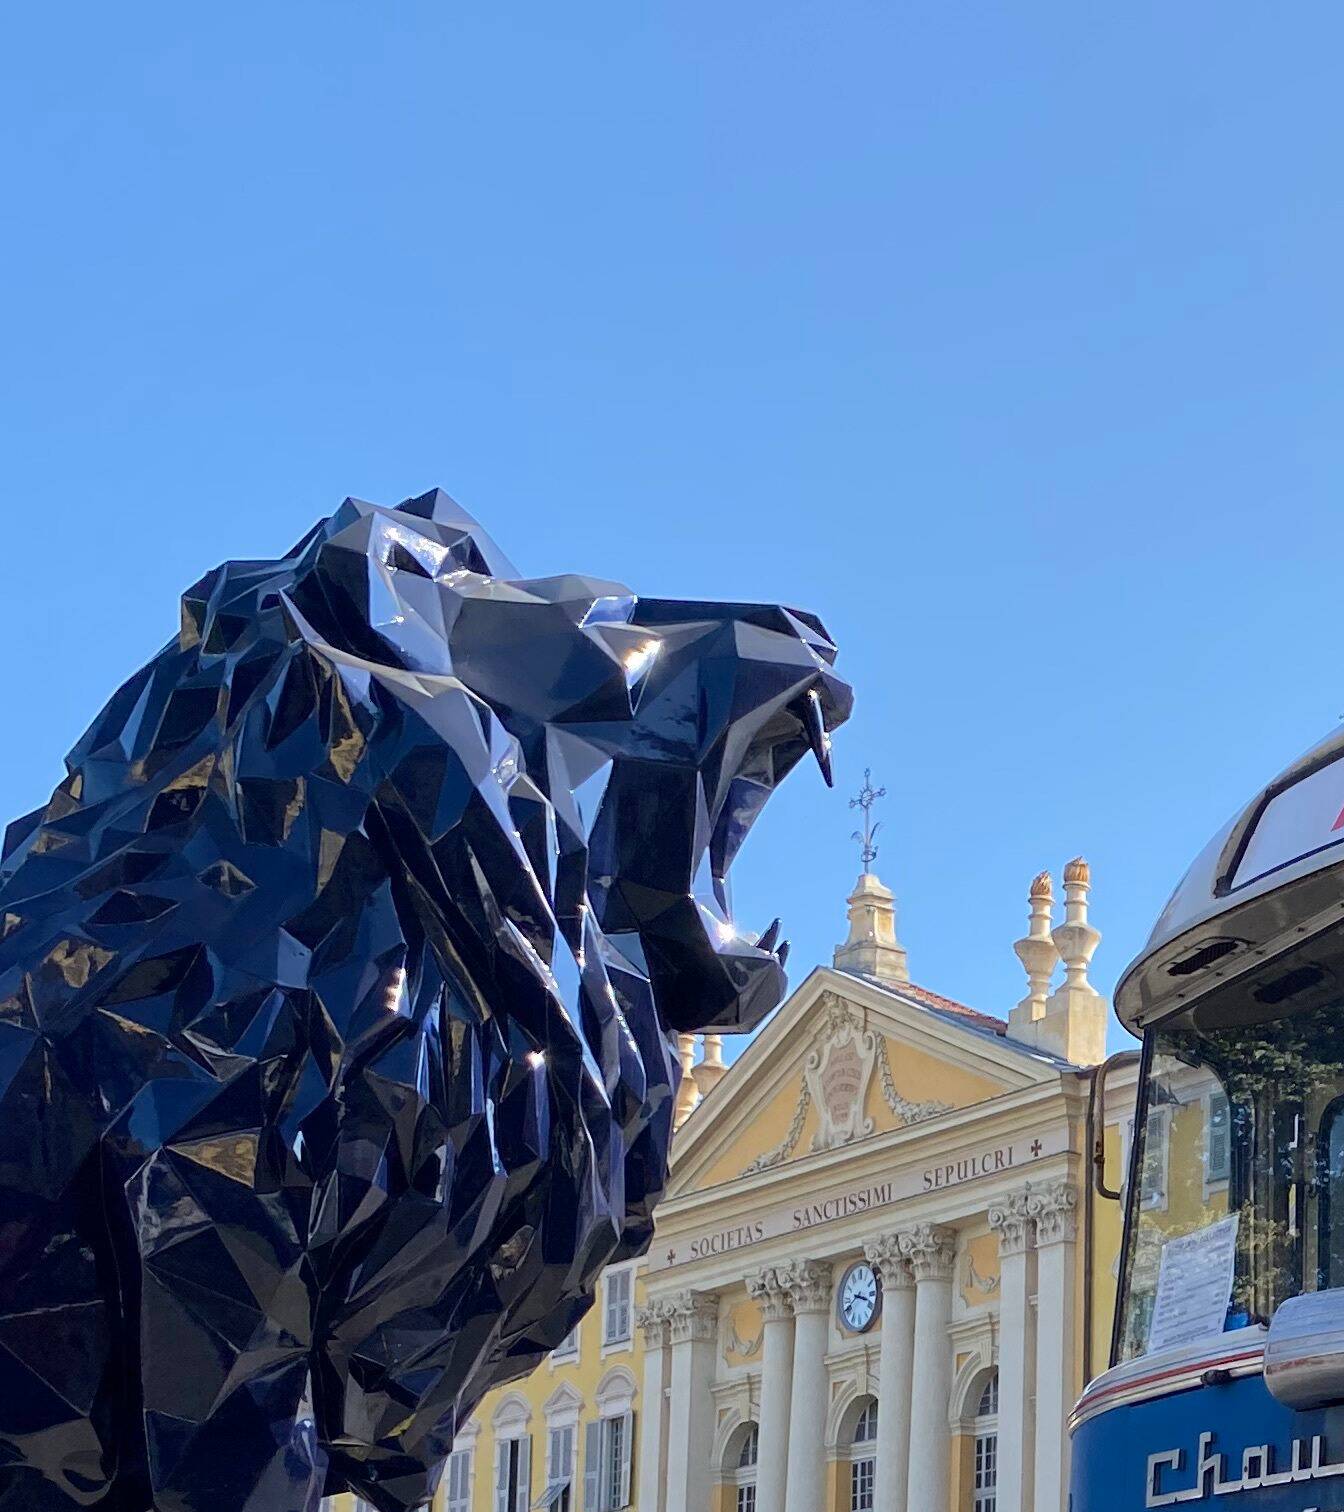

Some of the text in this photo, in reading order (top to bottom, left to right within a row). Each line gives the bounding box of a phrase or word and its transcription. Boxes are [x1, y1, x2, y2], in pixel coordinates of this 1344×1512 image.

[689, 1146, 1014, 1259] SOCIETAS SANCTISSIMI SEPULCRI
